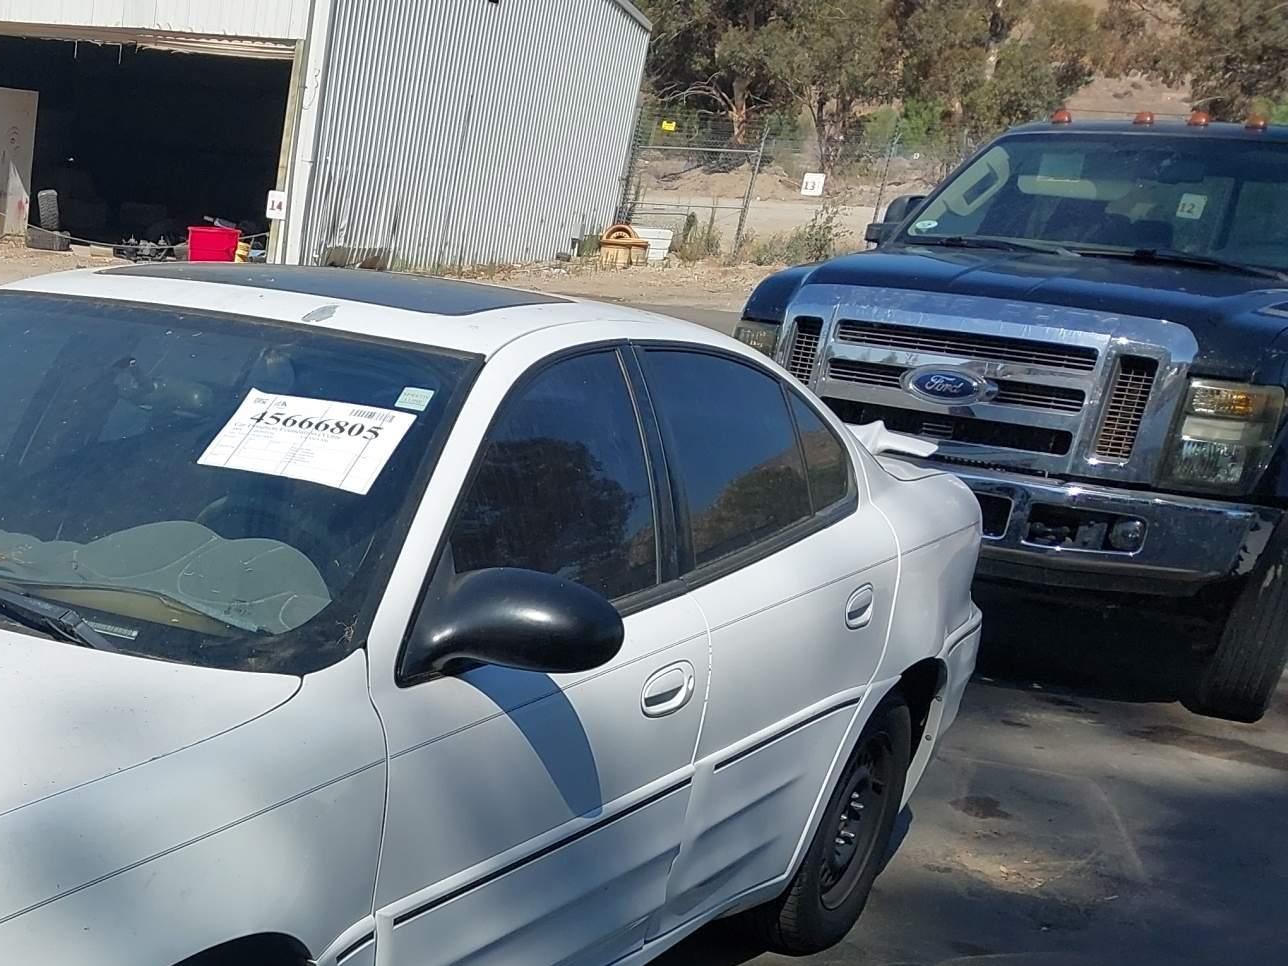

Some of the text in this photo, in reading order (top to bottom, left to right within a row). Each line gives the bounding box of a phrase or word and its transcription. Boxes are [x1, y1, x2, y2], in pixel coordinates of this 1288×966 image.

[269, 200, 283, 211] 14
[1180, 203, 1196, 214] 12
[924, 374, 964, 393] Ford
[249, 410, 384, 440] 45666805
